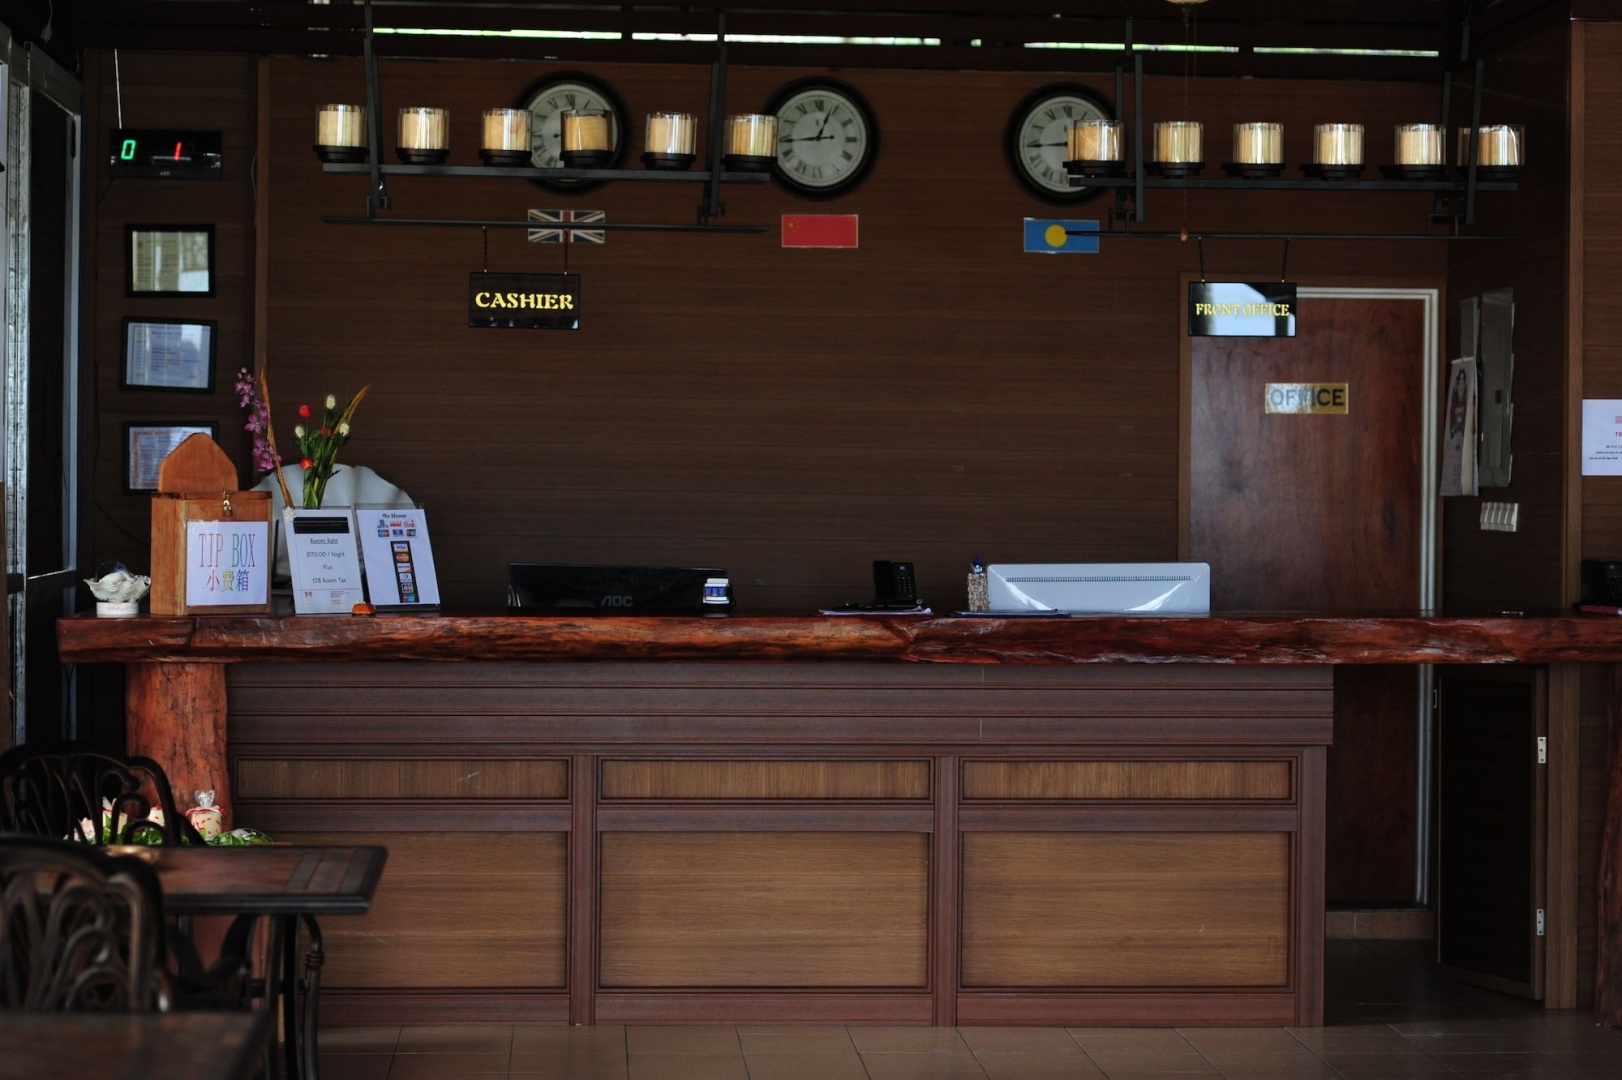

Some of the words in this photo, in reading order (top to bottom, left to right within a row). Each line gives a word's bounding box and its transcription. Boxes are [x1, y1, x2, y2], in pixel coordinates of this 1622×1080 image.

[120, 139, 137, 161] 0
[475, 291, 574, 310] CASHIER
[1195, 303, 1241, 316] FRONT
[1242, 303, 1290, 317] OFFICE
[1270, 388, 1345, 407] OFFICE
[198, 533, 224, 568] TIP
[231, 533, 256, 568] BOX
[331, 550, 345, 558] Night
[206, 569, 250, 592] 小费箱
[600, 594, 633, 608] AOC
